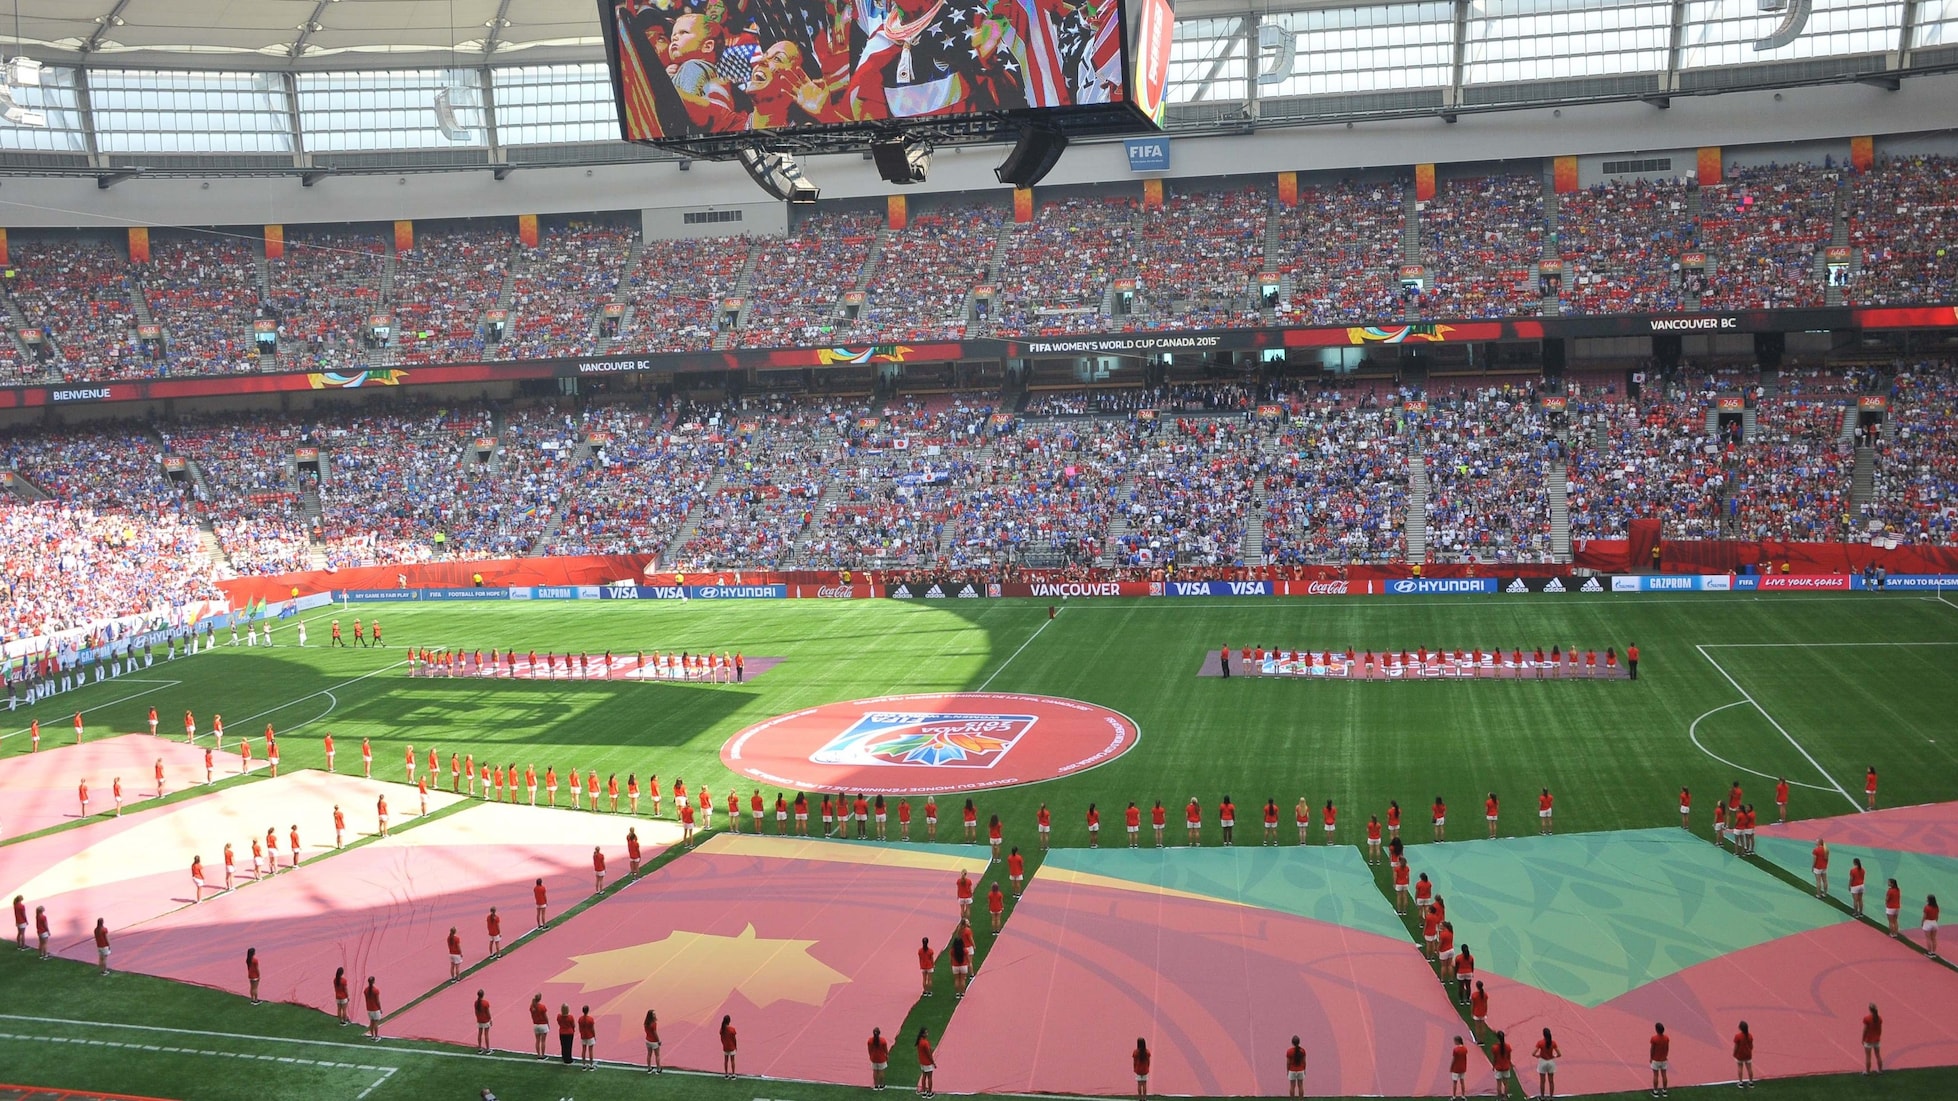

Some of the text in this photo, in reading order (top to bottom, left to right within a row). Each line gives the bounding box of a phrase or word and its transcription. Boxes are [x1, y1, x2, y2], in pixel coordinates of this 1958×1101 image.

[1130, 145, 1162, 158] FIFA
[1650, 318, 1736, 330] VANCOUVER BC
[1030, 344, 1051, 352] FIFA
[1052, 342, 1098, 352] WOMEN'S
[1099, 340, 1133, 350] WORLD
[1135, 340, 1154, 348] CUP
[1156, 338, 1196, 348] CANADA
[579, 360, 650, 372] VANCOUVER BC
[53, 388, 111, 401] BIENVENUE
[1174, 582, 1210, 595] VISA
[1228, 582, 1265, 595] VISA
[1418, 580, 1484, 592] HYUNDAI
[1650, 578, 1692, 588] GAZPROM
[538, 588, 570, 598] GAZPROM
[608, 587, 638, 598] VISA
[652, 587, 684, 598] VISA
[720, 585, 776, 597] HYUNDAI
[1030, 583, 1120, 596] VANCOUVER
[921, 726, 1012, 734] CANADA
[977, 778, 1018, 786] COUPE
